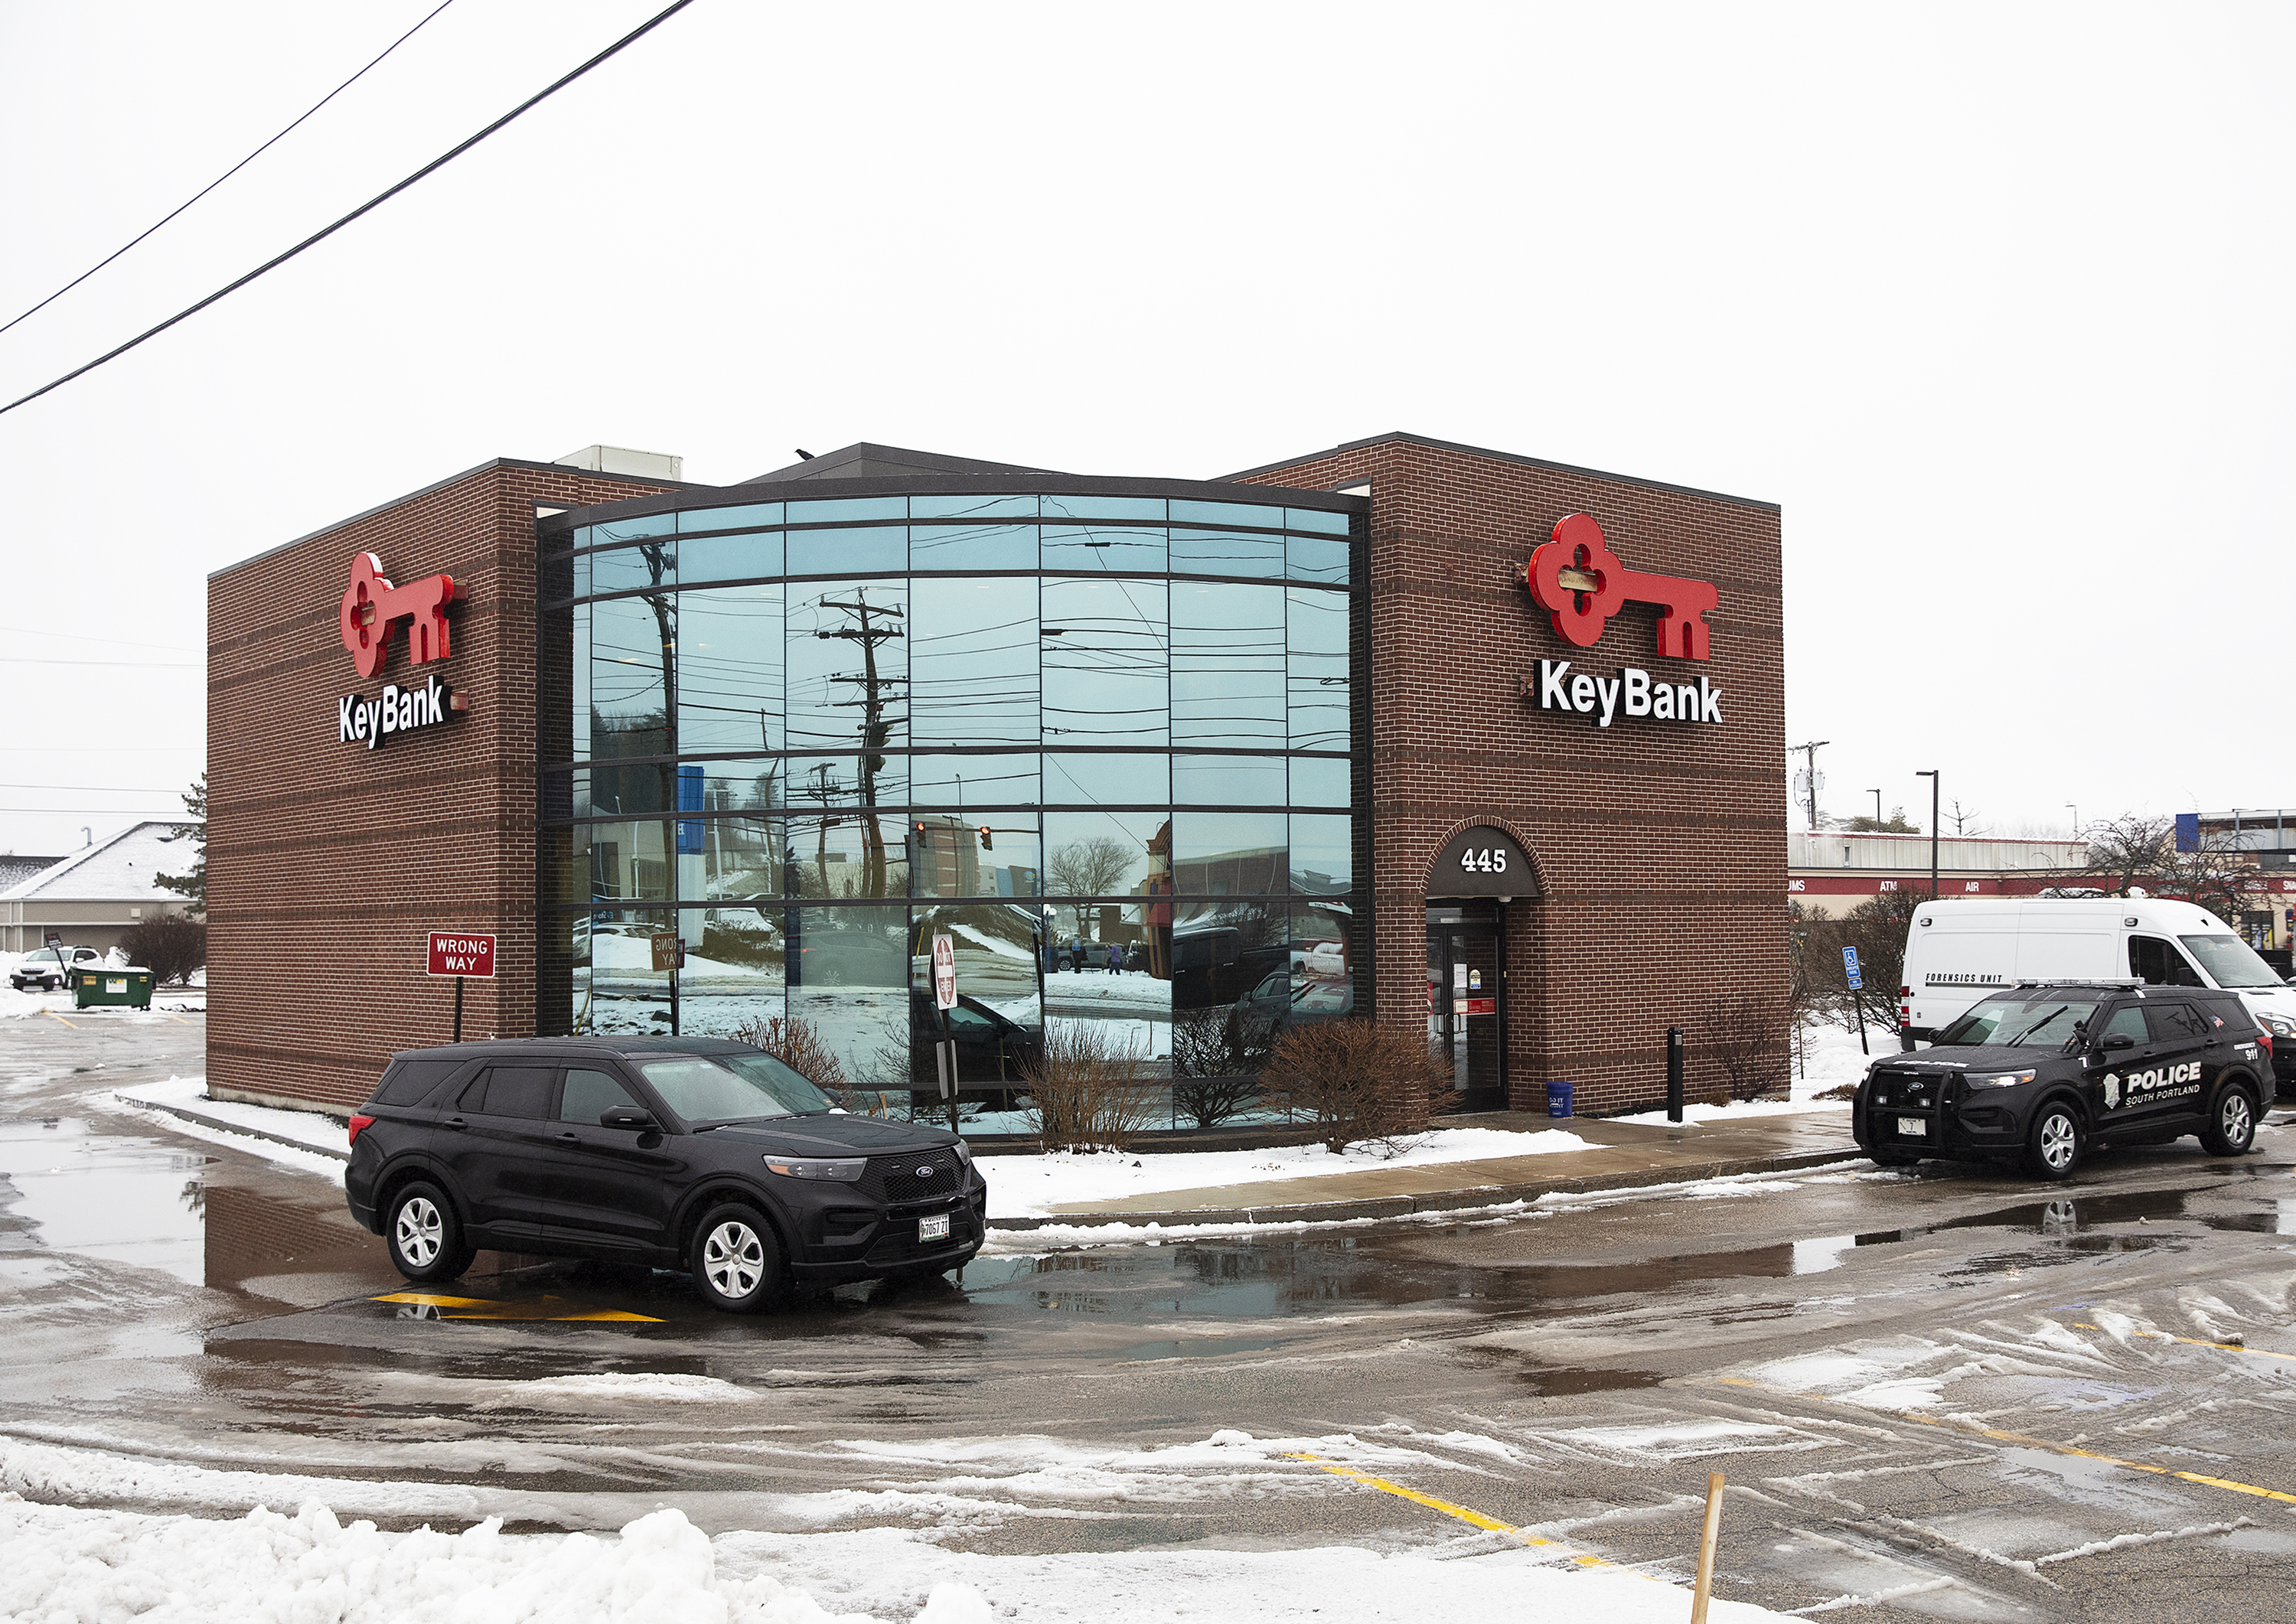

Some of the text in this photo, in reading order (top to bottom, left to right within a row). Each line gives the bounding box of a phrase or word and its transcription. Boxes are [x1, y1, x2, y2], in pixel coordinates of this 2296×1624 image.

[1541, 659, 1724, 727] KeyBank
[339, 675, 444, 749] KeyBank
[1461, 848, 1507, 872] 445
[1880, 881, 1897, 892] ATM
[1965, 882, 1979, 892] AIR
[436, 938, 488, 954] WRONG
[445, 956, 477, 970] WAY
[1926, 973, 2002, 983] FORENSICS UNIT
[2245, 1048, 2258, 1061] 911
[2127, 1061, 2201, 1094] POLICE
[2125, 1084, 2200, 1106] SOUTH PORTLAND
[925, 1222, 940, 1235] 7067
